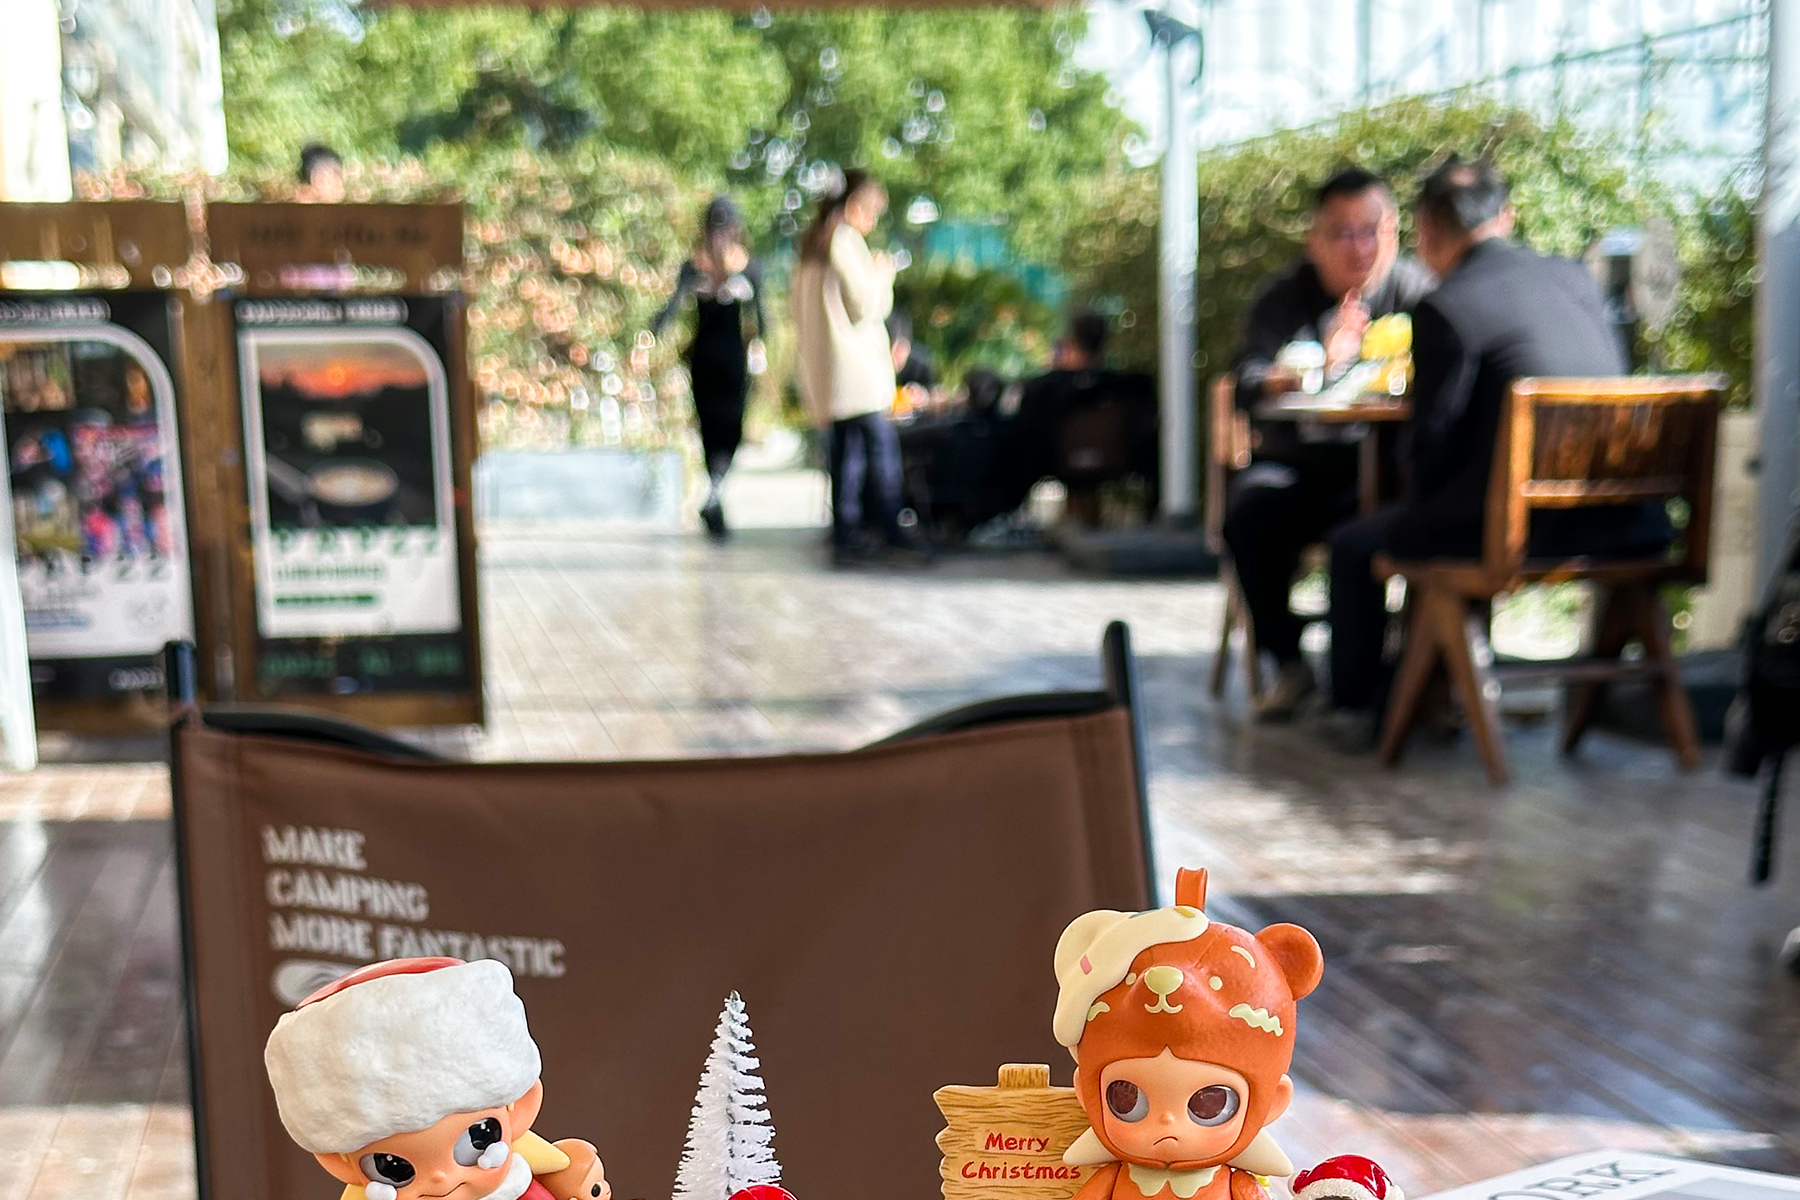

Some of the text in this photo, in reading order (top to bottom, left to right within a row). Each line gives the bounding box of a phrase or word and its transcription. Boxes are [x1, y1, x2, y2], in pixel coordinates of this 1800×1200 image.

[262, 825, 367, 870] MAKE
[266, 869, 429, 922] CAMPING
[268, 912, 567, 978] MORE FANTASTIC
[984, 1132, 1050, 1152] Merry
[961, 1161, 1081, 1180] Christmas
